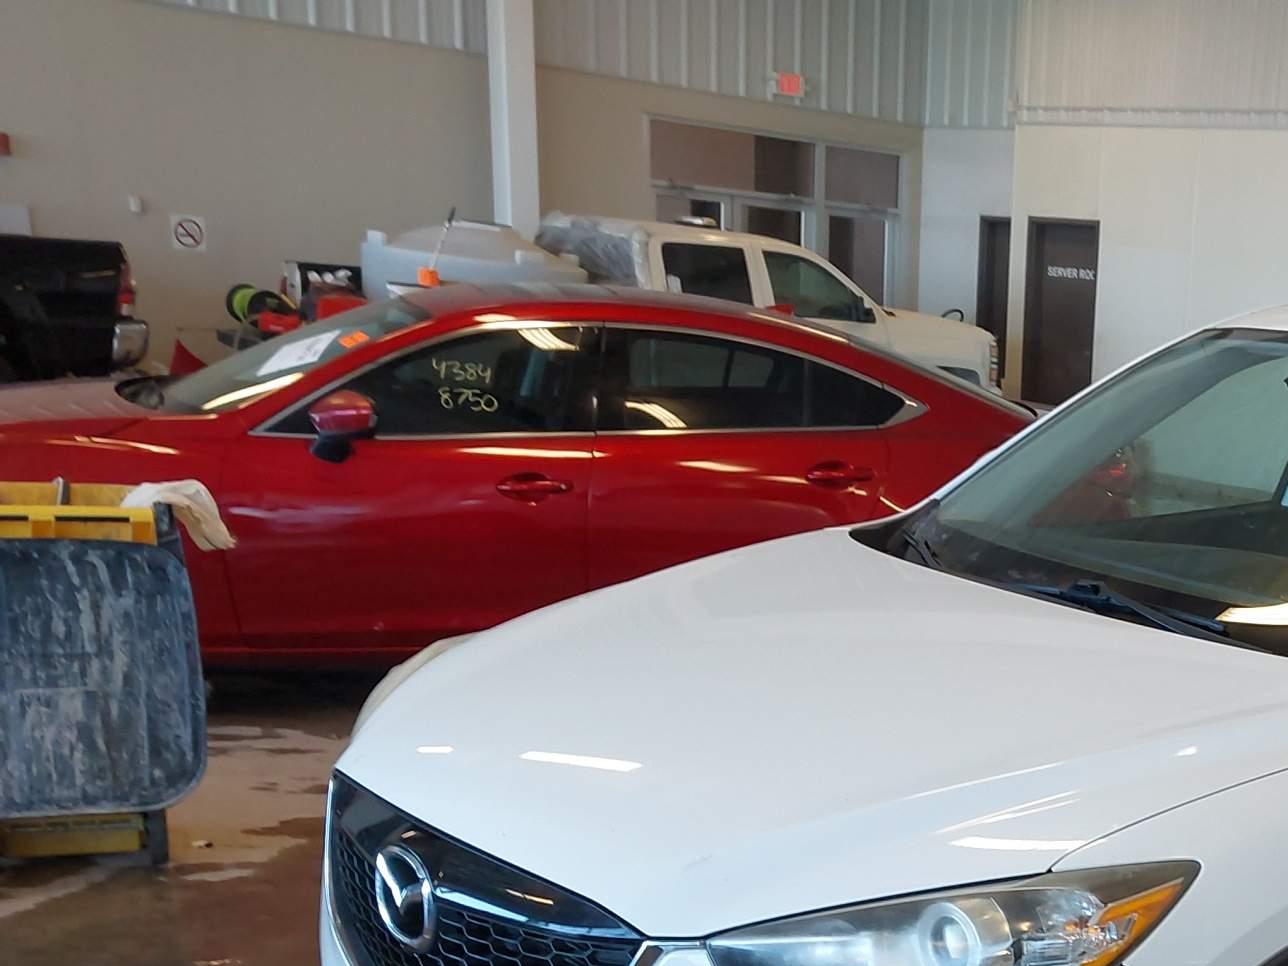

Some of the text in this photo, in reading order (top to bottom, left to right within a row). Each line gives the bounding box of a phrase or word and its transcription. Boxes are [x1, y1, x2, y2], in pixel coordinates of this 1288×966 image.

[1047, 265, 1078, 279] SERVER
[432, 358, 491, 383] 4384
[438, 387, 498, 412] 8750
